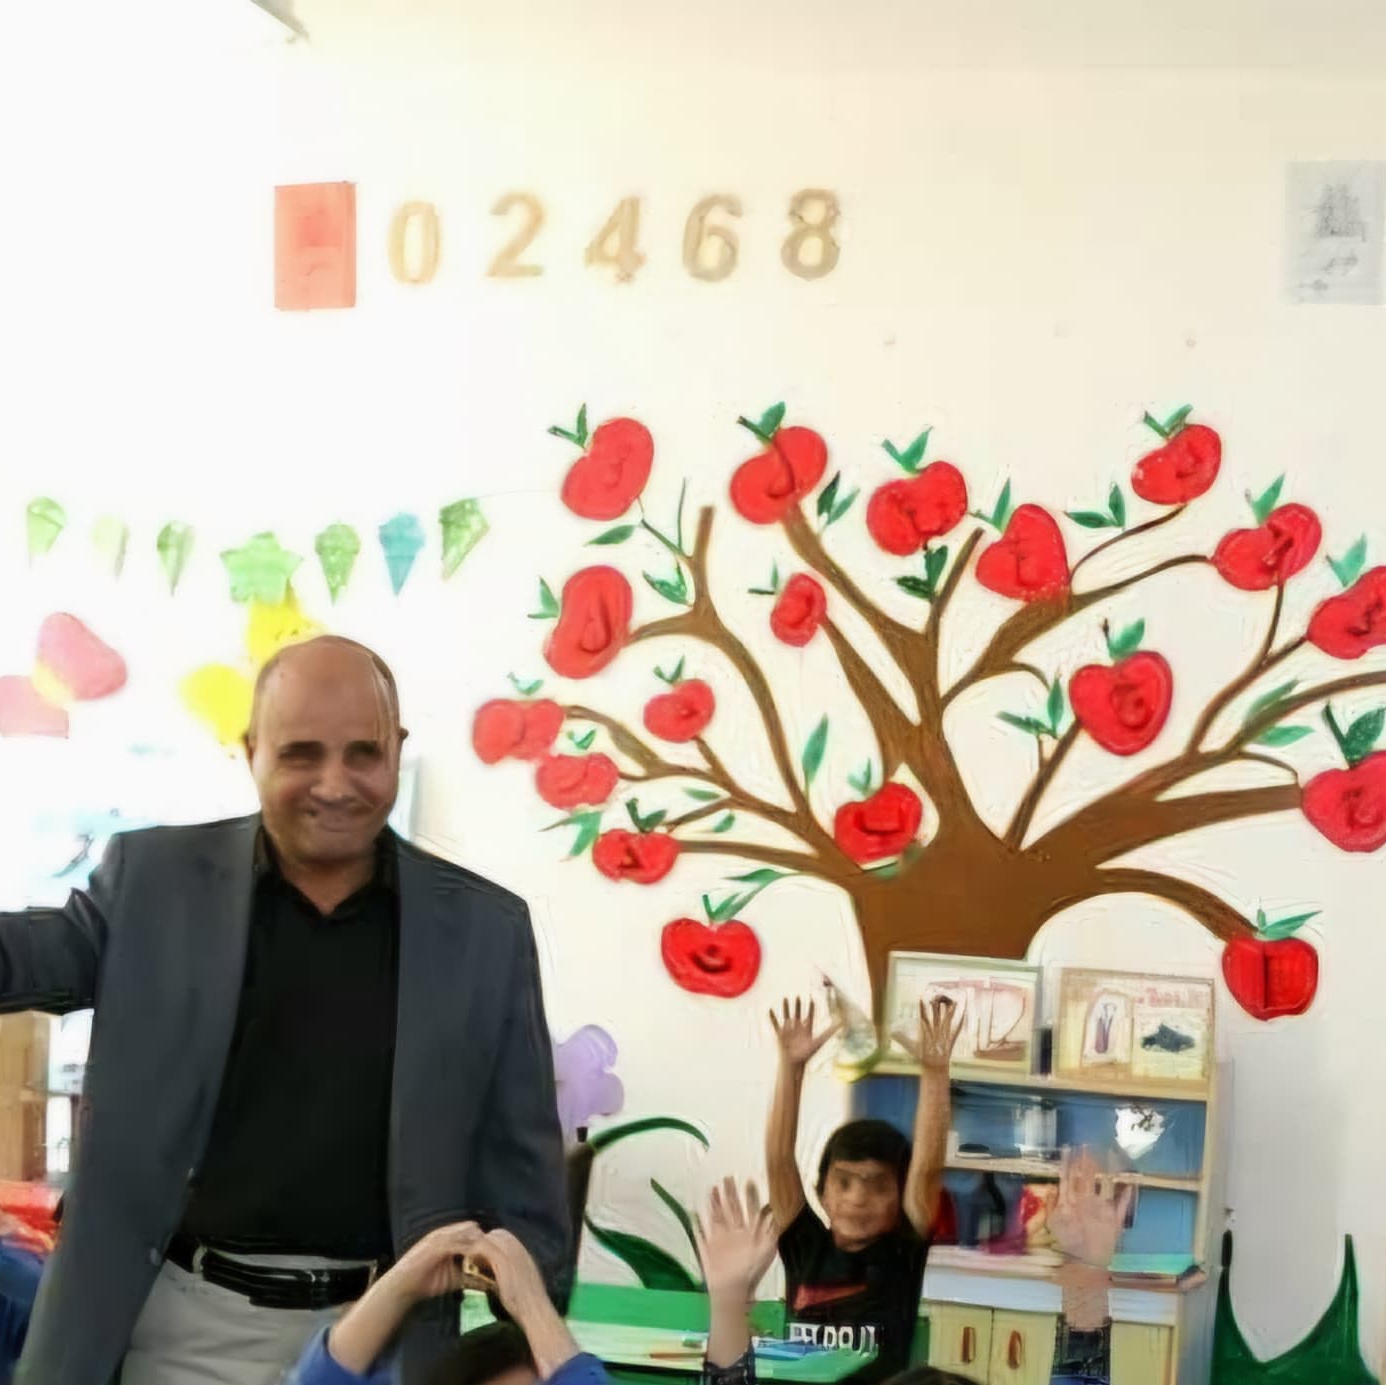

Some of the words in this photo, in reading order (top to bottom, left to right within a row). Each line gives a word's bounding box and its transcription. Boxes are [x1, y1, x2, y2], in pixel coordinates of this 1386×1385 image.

[387, 201, 442, 285] 0
[486, 190, 545, 277] 2
[584, 196, 647, 284] 4
[682, 193, 743, 283] 6
[780, 188, 841, 281] 8
